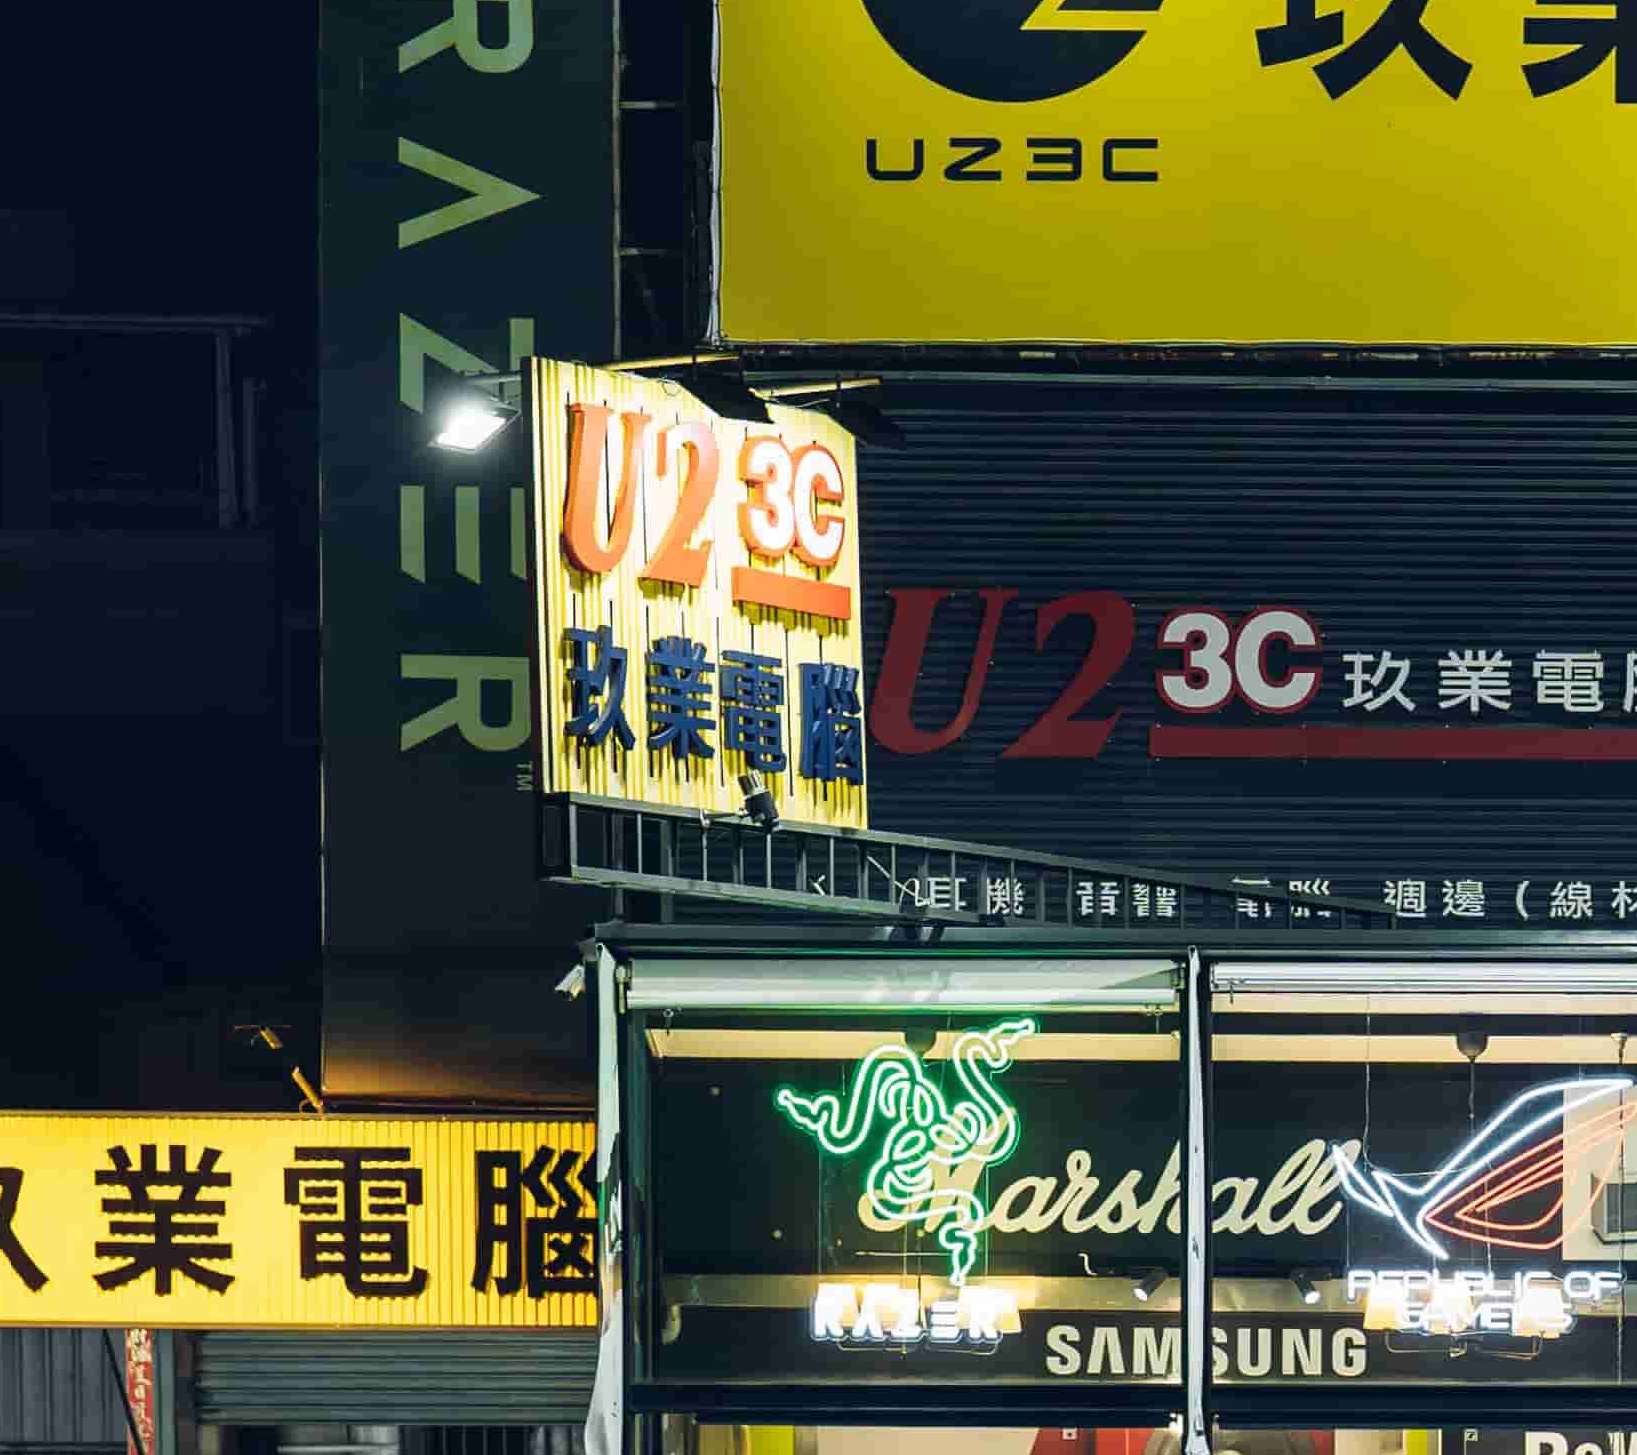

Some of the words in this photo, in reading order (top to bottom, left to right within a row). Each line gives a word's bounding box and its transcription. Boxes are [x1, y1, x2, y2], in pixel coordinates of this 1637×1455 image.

[564, 624, 862, 786] 玖業電腦
[1046, 1325, 1367, 1377] SAMSUNG
